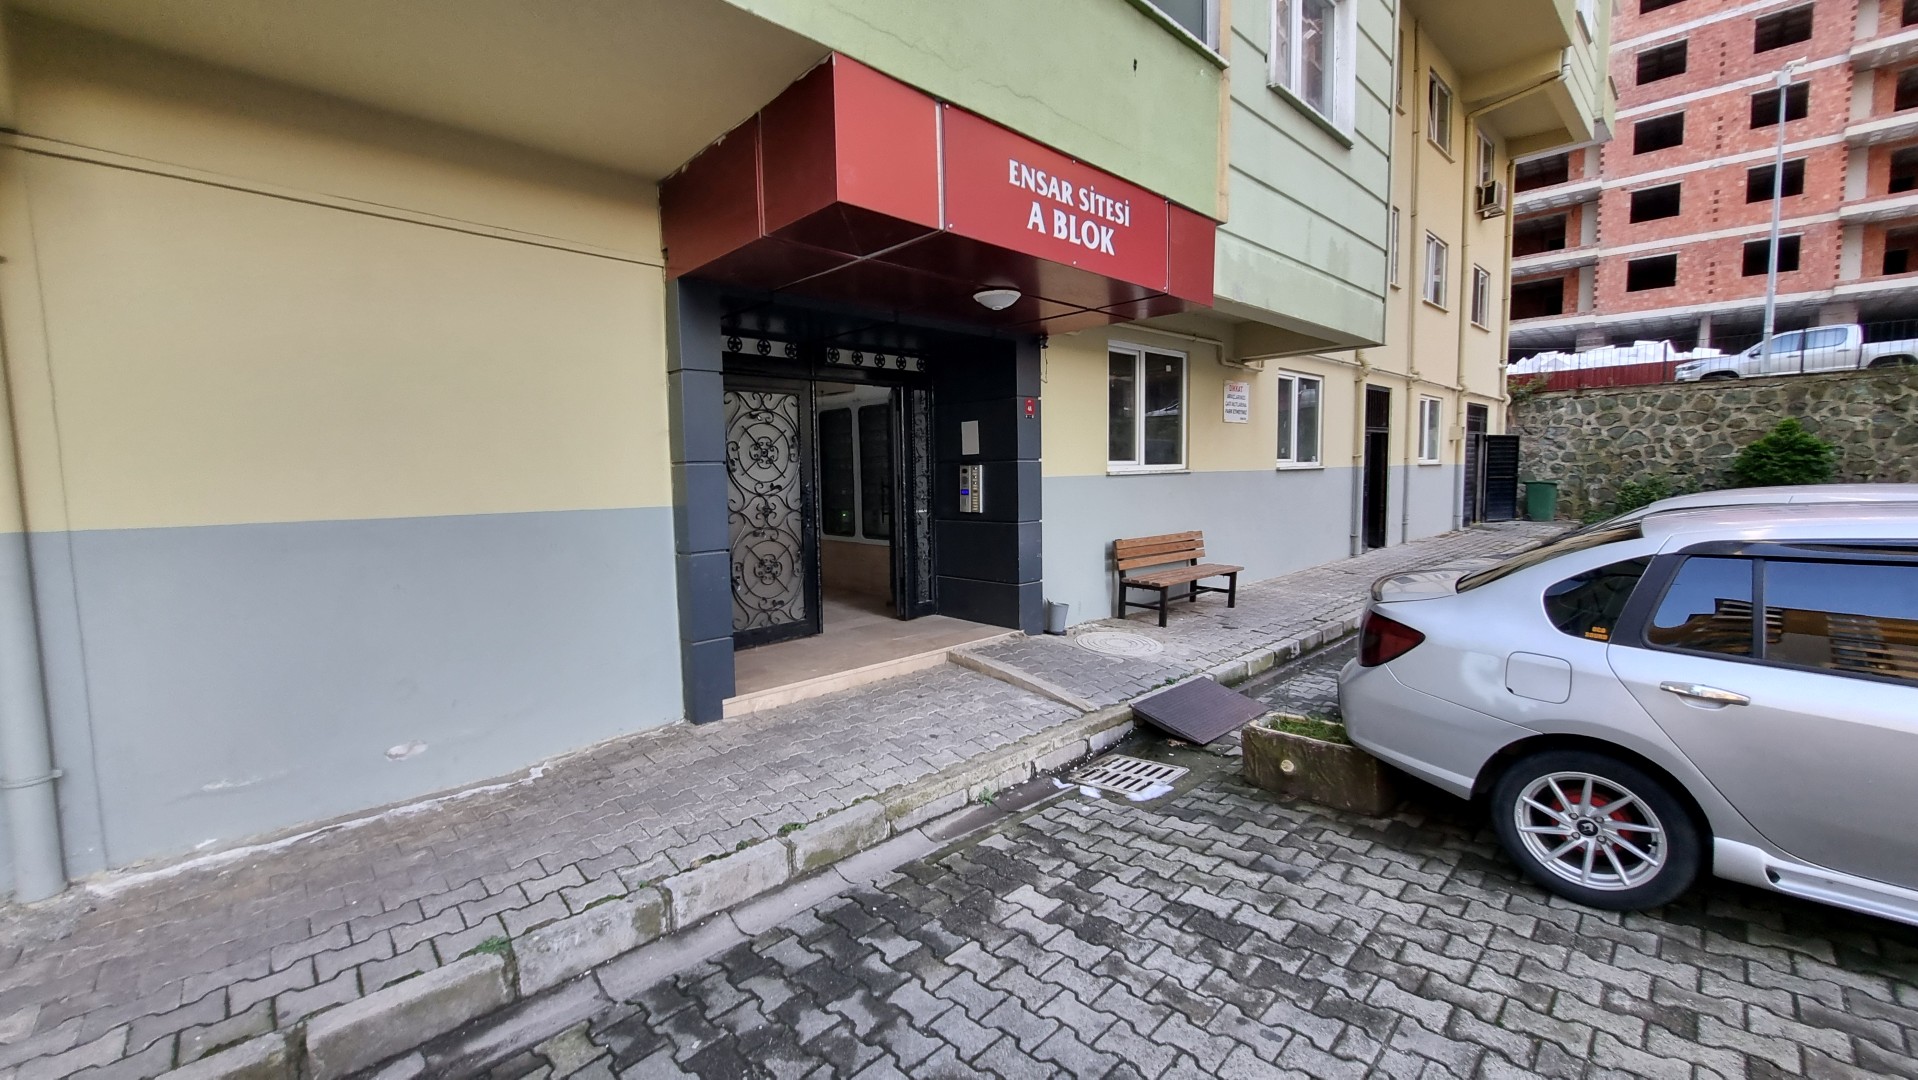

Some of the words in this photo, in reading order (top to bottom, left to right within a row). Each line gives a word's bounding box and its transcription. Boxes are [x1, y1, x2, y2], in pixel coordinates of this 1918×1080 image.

[1009, 158, 1074, 207] ENSAR
[1078, 185, 1130, 227] SİTESİ
[1026, 201, 1046, 234] A
[1053, 208, 1115, 256] BLOK
